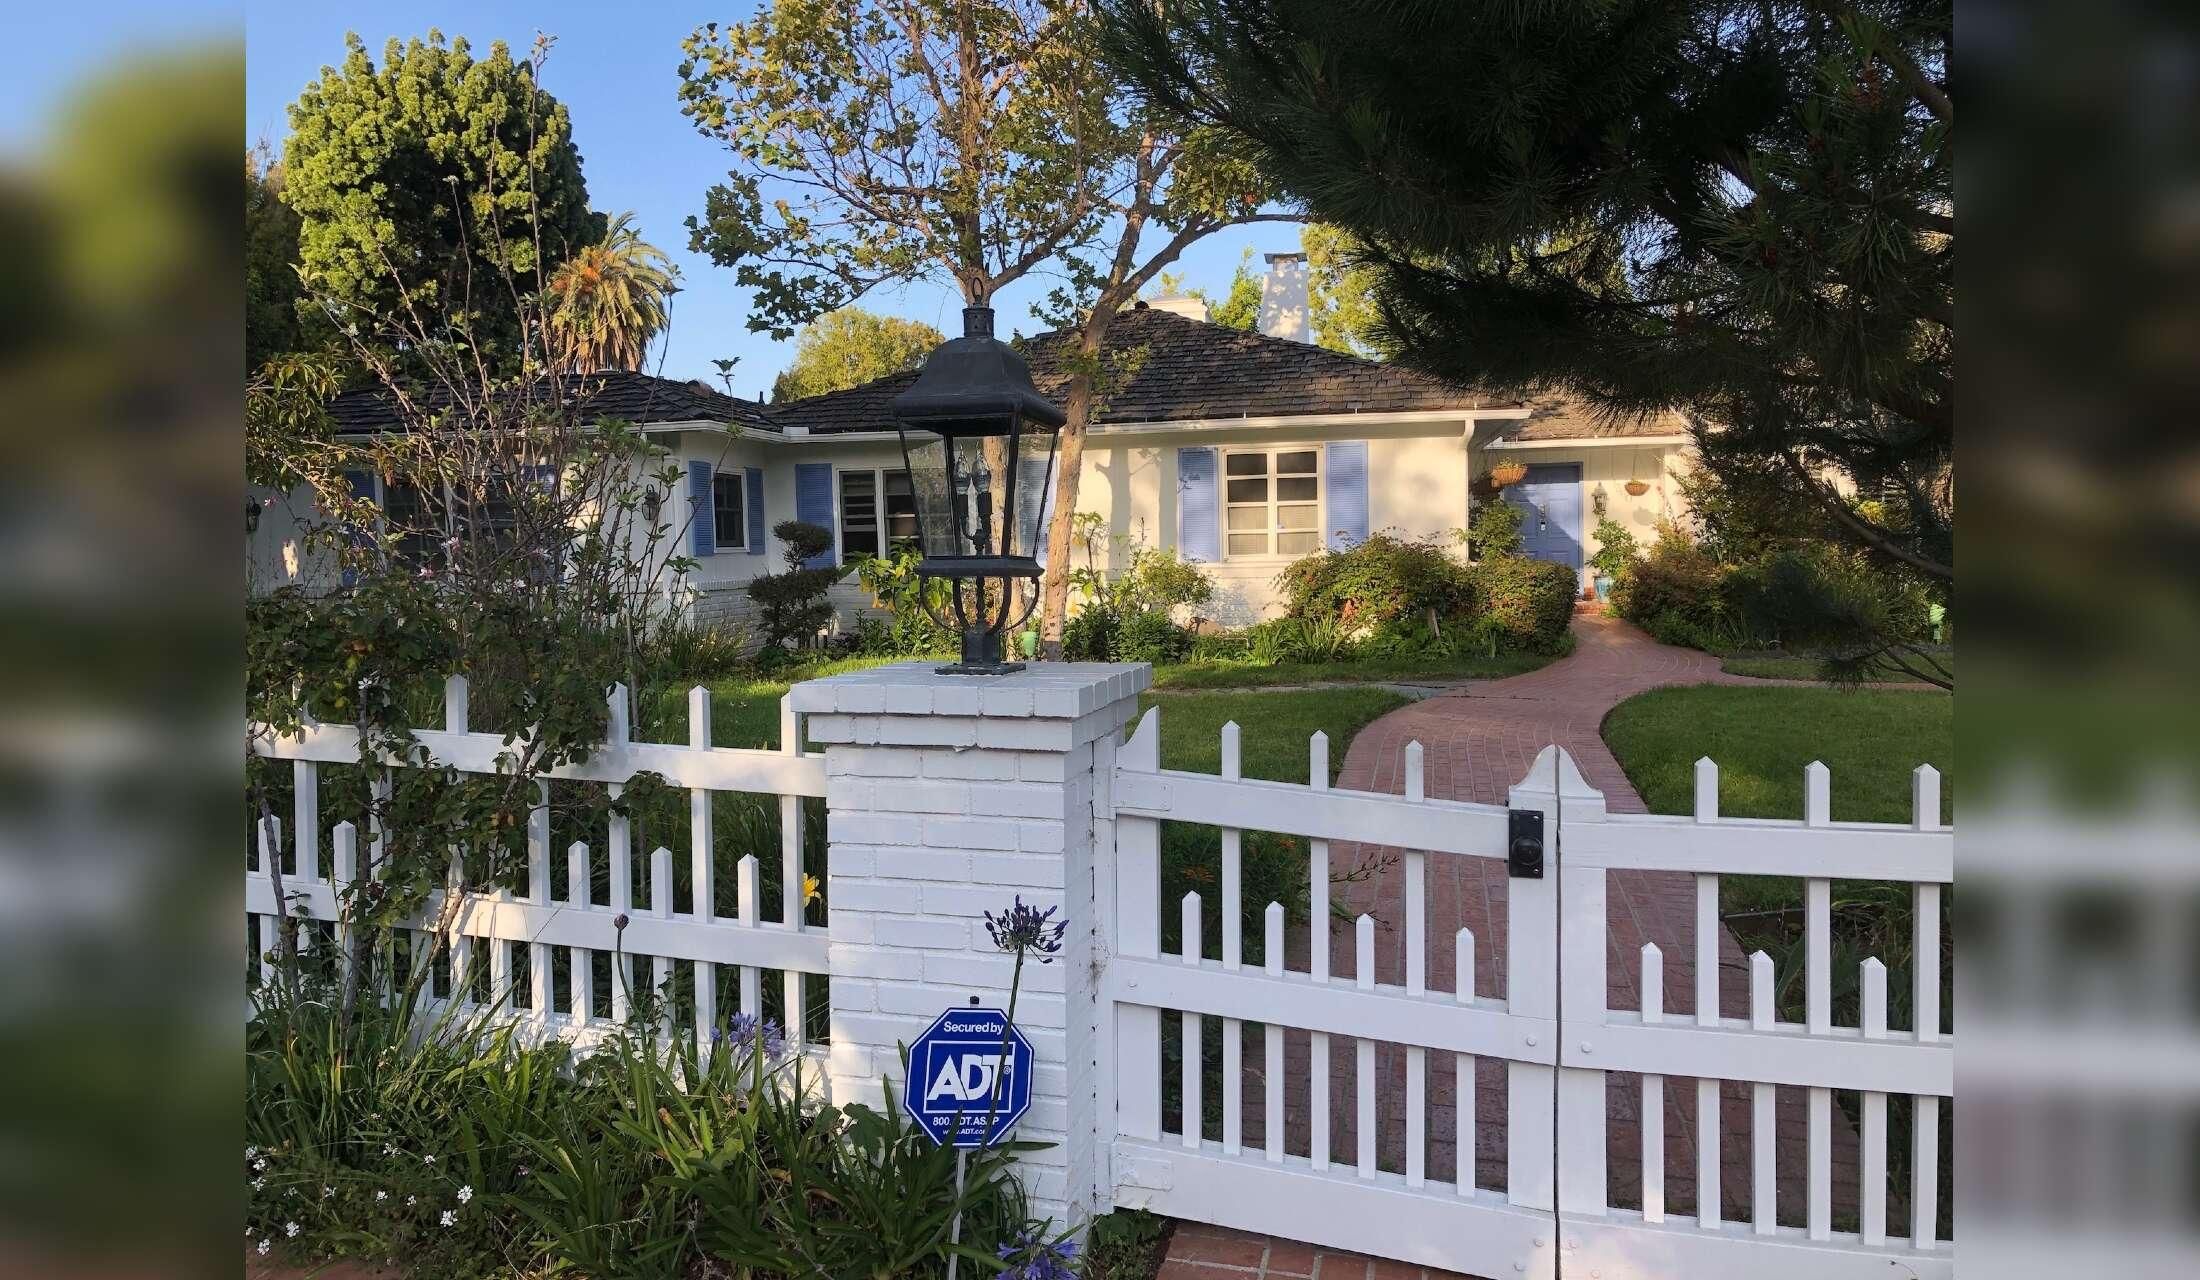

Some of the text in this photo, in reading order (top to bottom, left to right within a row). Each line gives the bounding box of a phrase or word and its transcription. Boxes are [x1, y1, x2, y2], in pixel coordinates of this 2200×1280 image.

[943, 1021, 1004, 1036] Secured by
[926, 1054, 1013, 1101] ADT
[932, 1116, 1000, 1126] 800.DT.ASP
